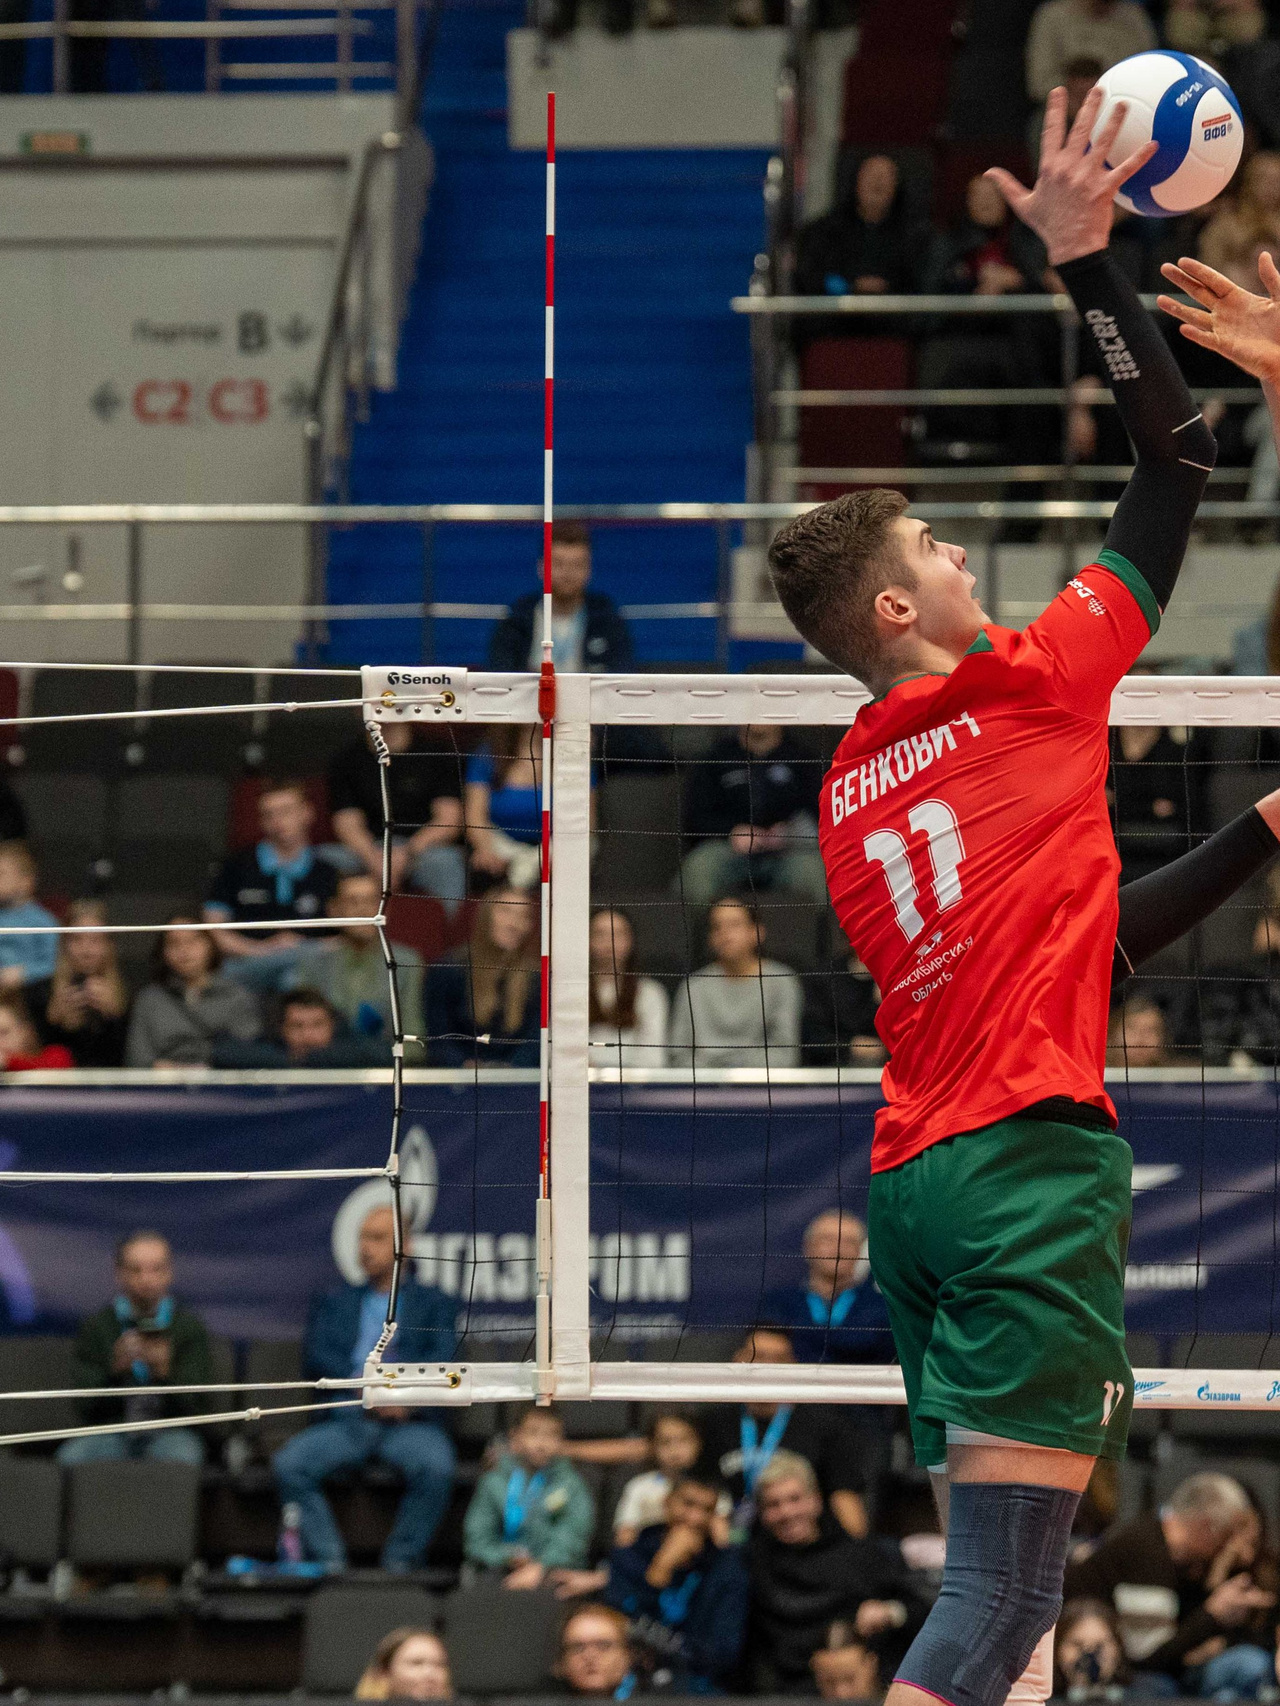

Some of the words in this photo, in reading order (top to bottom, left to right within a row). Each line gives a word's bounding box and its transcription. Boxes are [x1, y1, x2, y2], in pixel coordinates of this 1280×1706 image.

[401, 673, 451, 685] Senoh
[831, 711, 981, 827] БЕНКОВИЧ
[862, 798, 964, 944] 11
